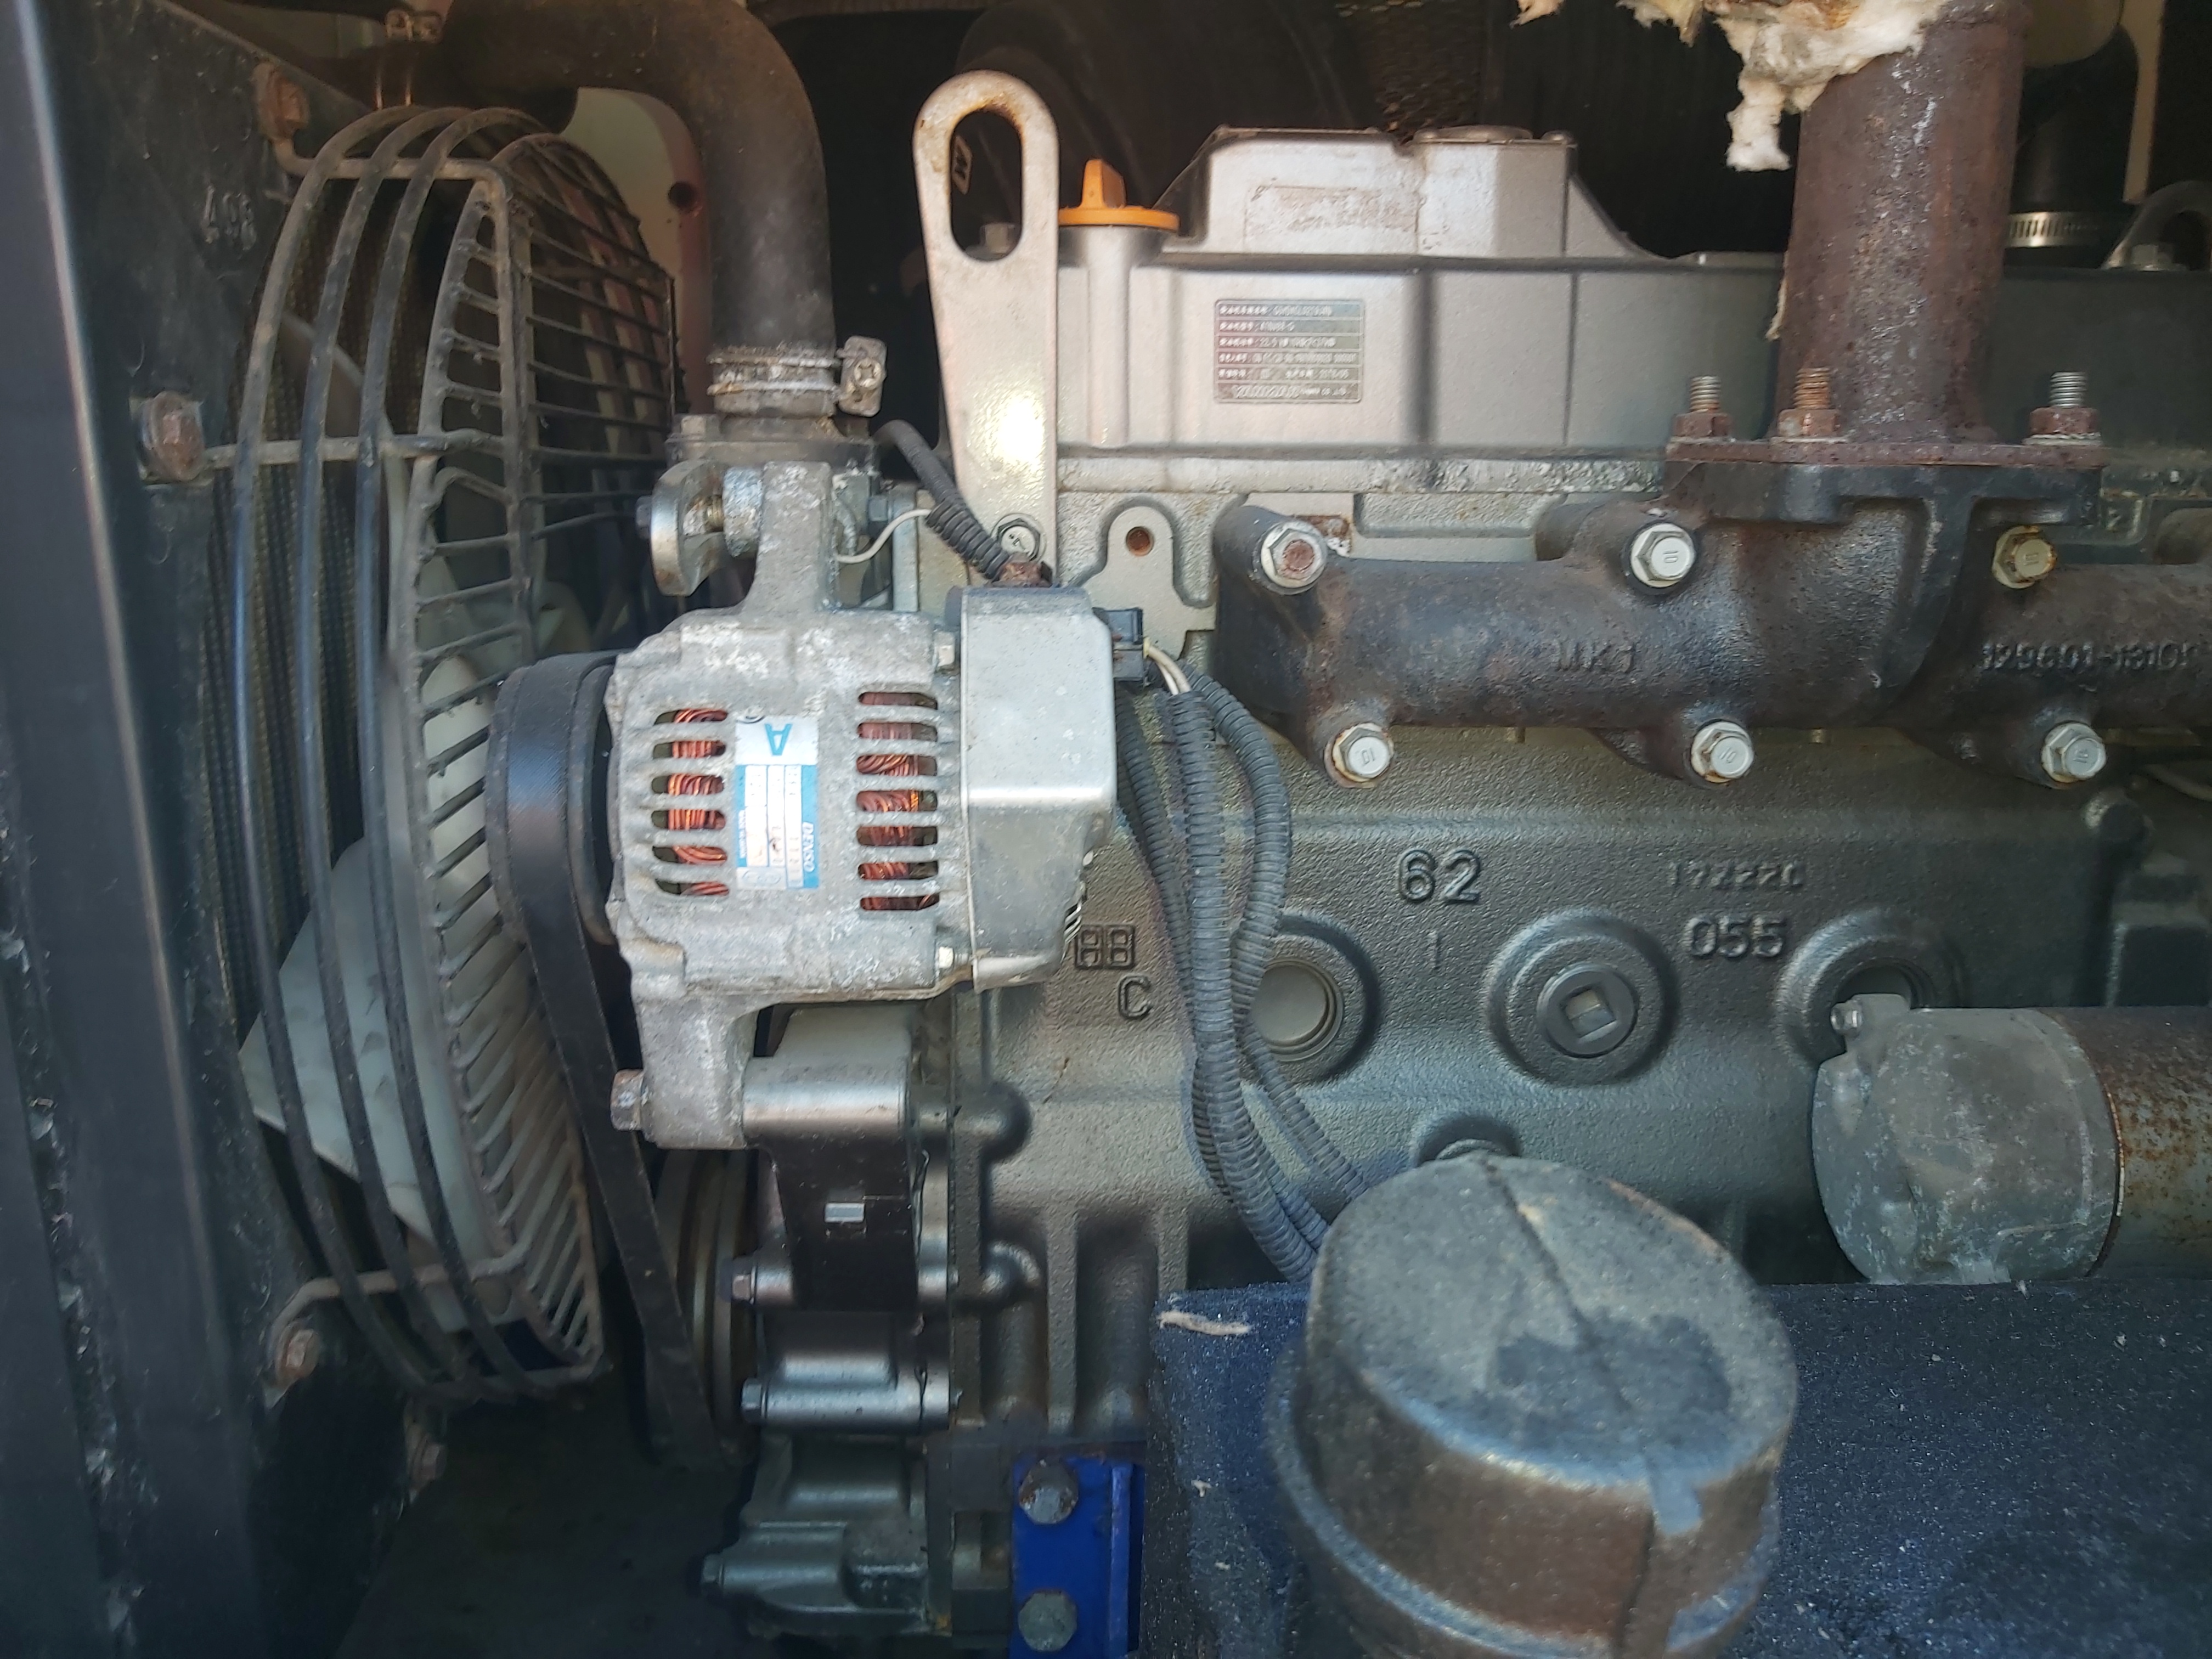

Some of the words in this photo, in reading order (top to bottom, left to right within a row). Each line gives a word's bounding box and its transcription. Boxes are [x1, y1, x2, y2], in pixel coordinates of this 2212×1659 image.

[765, 724, 793, 756] A
[802, 821, 815, 872] DENSO
[1397, 848, 1482, 903] 62
[1683, 913, 1786, 958] 055
[1118, 973, 1152, 1019] C
